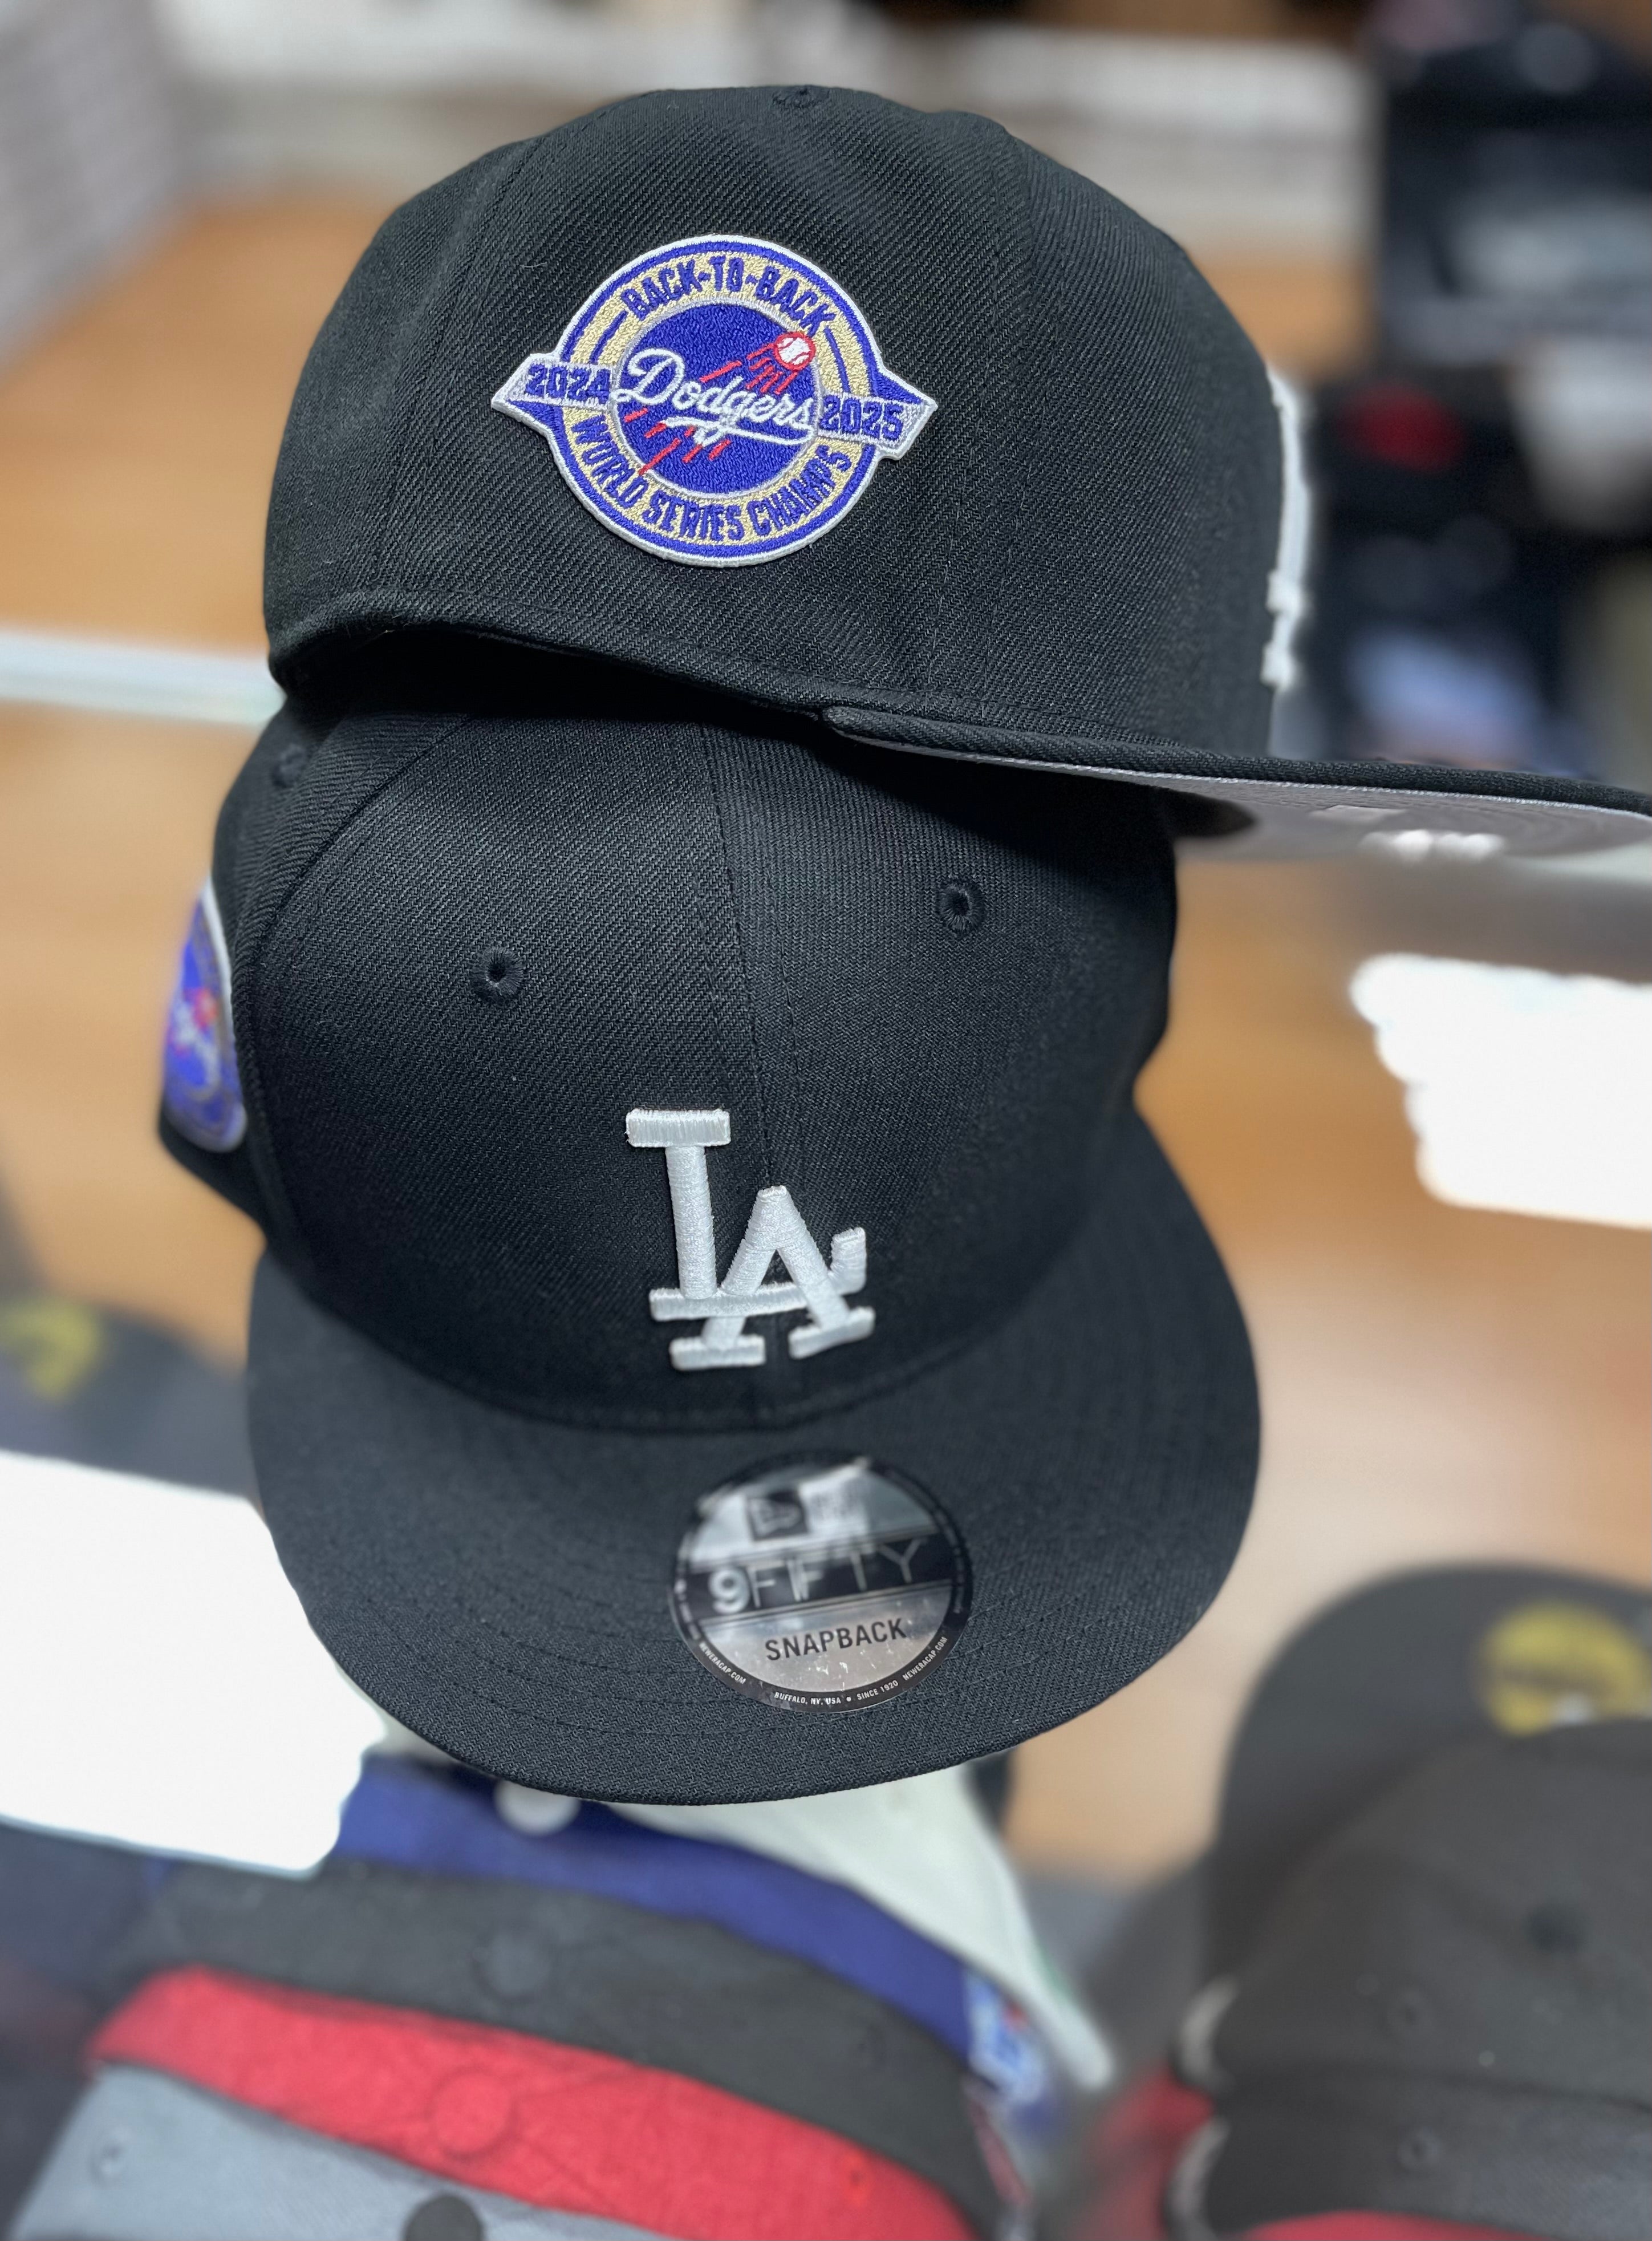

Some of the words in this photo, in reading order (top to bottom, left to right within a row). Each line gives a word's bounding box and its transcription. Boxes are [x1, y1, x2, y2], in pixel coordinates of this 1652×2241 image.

[620, 256, 836, 334] BACK-TO-BACK
[524, 364, 609, 404] 2024
[611, 347, 817, 446] Dodgers
[820, 399, 904, 439] 2025
[570, 415, 649, 508] WORLD
[642, 489, 744, 541] SERIES
[747, 445, 852, 536] CHAMPS
[625, 1108, 876, 1370] LA
[765, 1618, 907, 1661] SNAPBACK
[903, 1636, 948, 1681] NEWERACAP.COM
[699, 1641, 746, 1684] NEWERACAP.COM
[774, 1691, 808, 1705] BUFFALO,
[857, 1688, 879, 1701] SINCE
[880, 1680, 899, 1692] 1920
